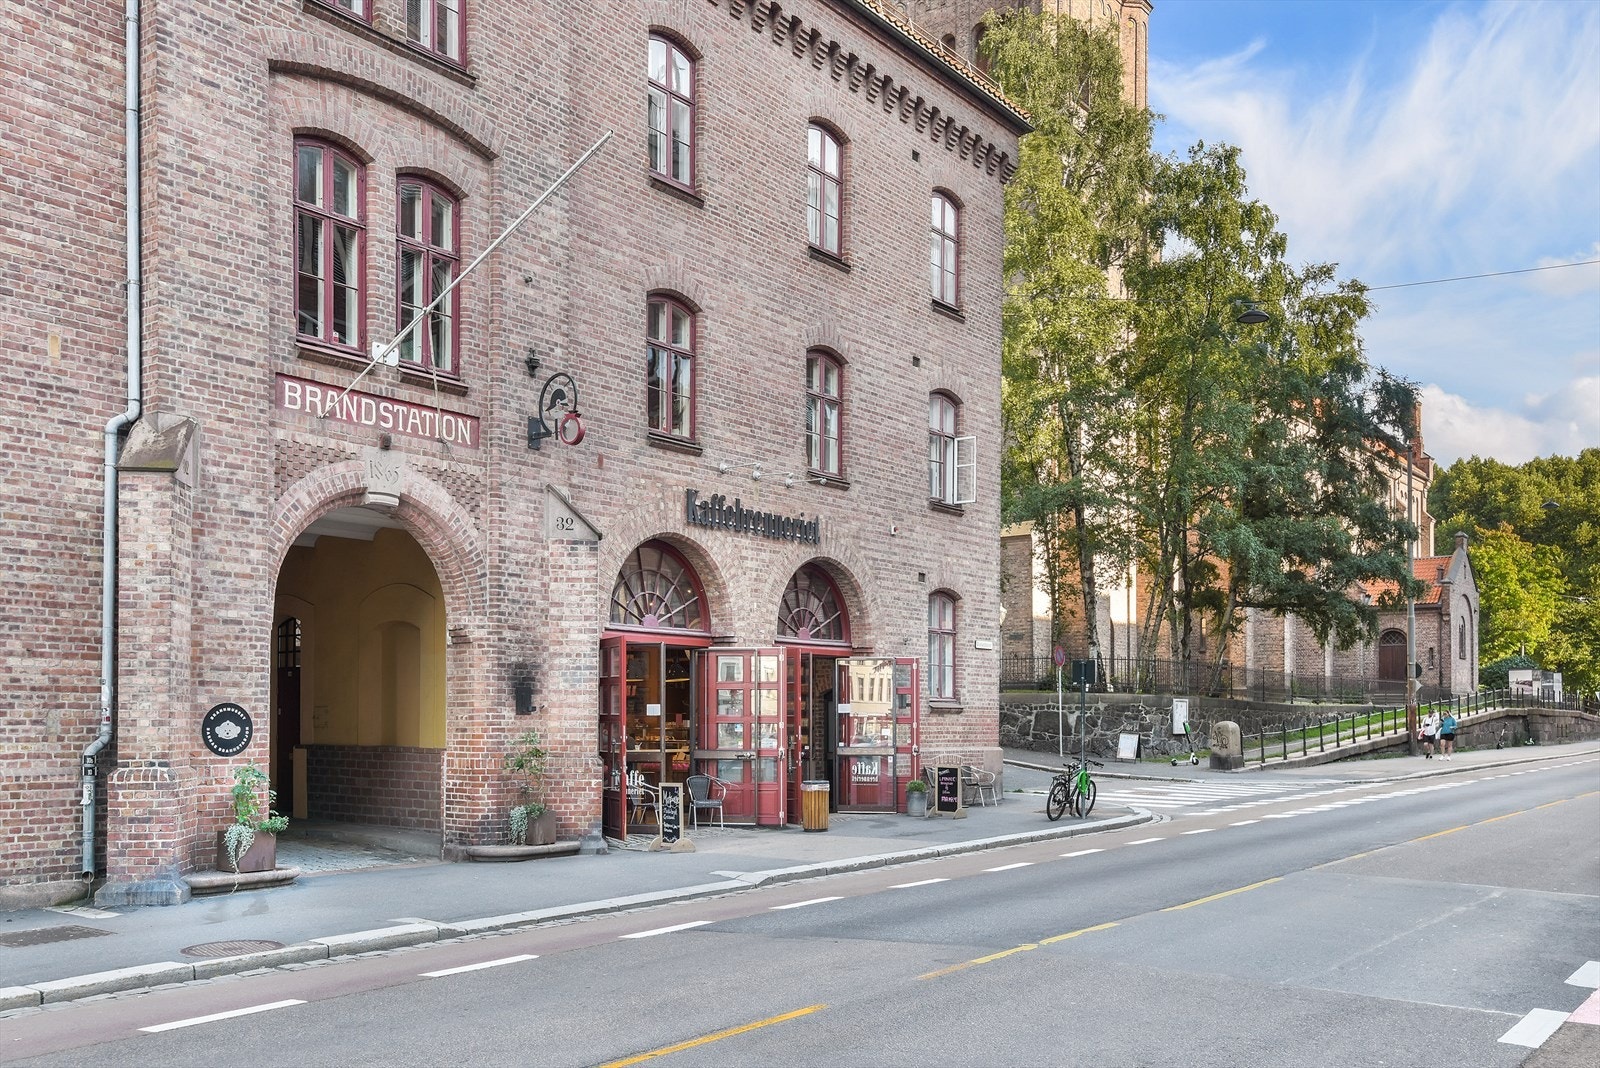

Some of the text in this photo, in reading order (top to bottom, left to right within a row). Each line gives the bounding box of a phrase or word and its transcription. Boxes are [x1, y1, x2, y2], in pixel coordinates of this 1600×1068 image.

[283, 381, 472, 445] BRANDSTATION
[556, 516, 574, 531] 32
[687, 488, 820, 545] Kaffebrenneriet
